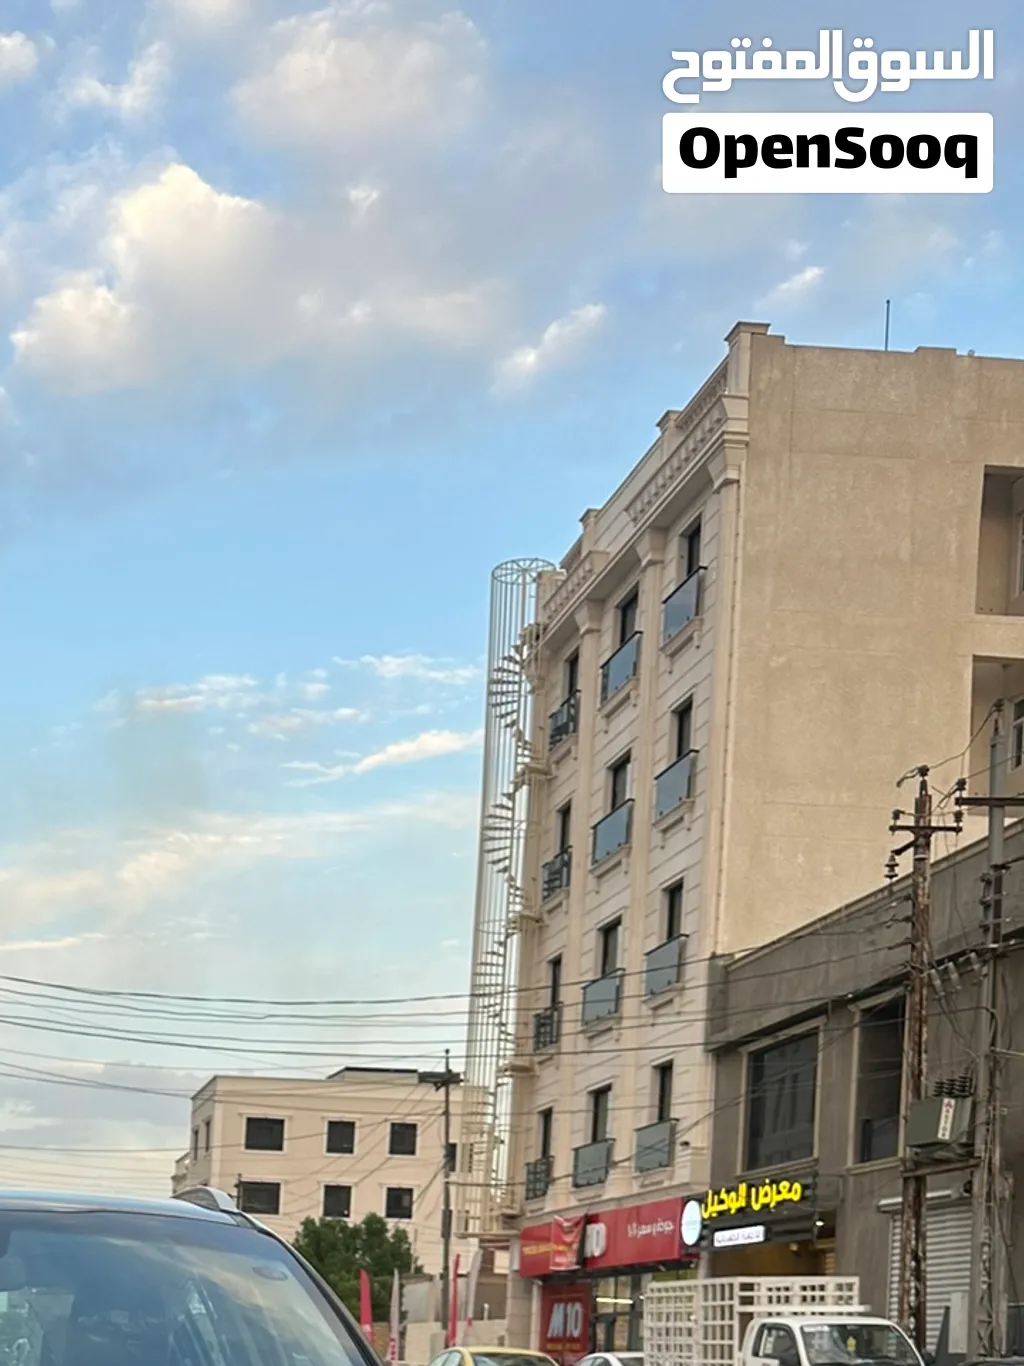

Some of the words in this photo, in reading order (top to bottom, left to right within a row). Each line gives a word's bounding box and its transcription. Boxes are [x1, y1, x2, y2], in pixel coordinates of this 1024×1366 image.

[701, 1182, 747, 1219] الوكيل
[751, 1178, 802, 1212] معرض
[547, 1301, 583, 1338] M10
